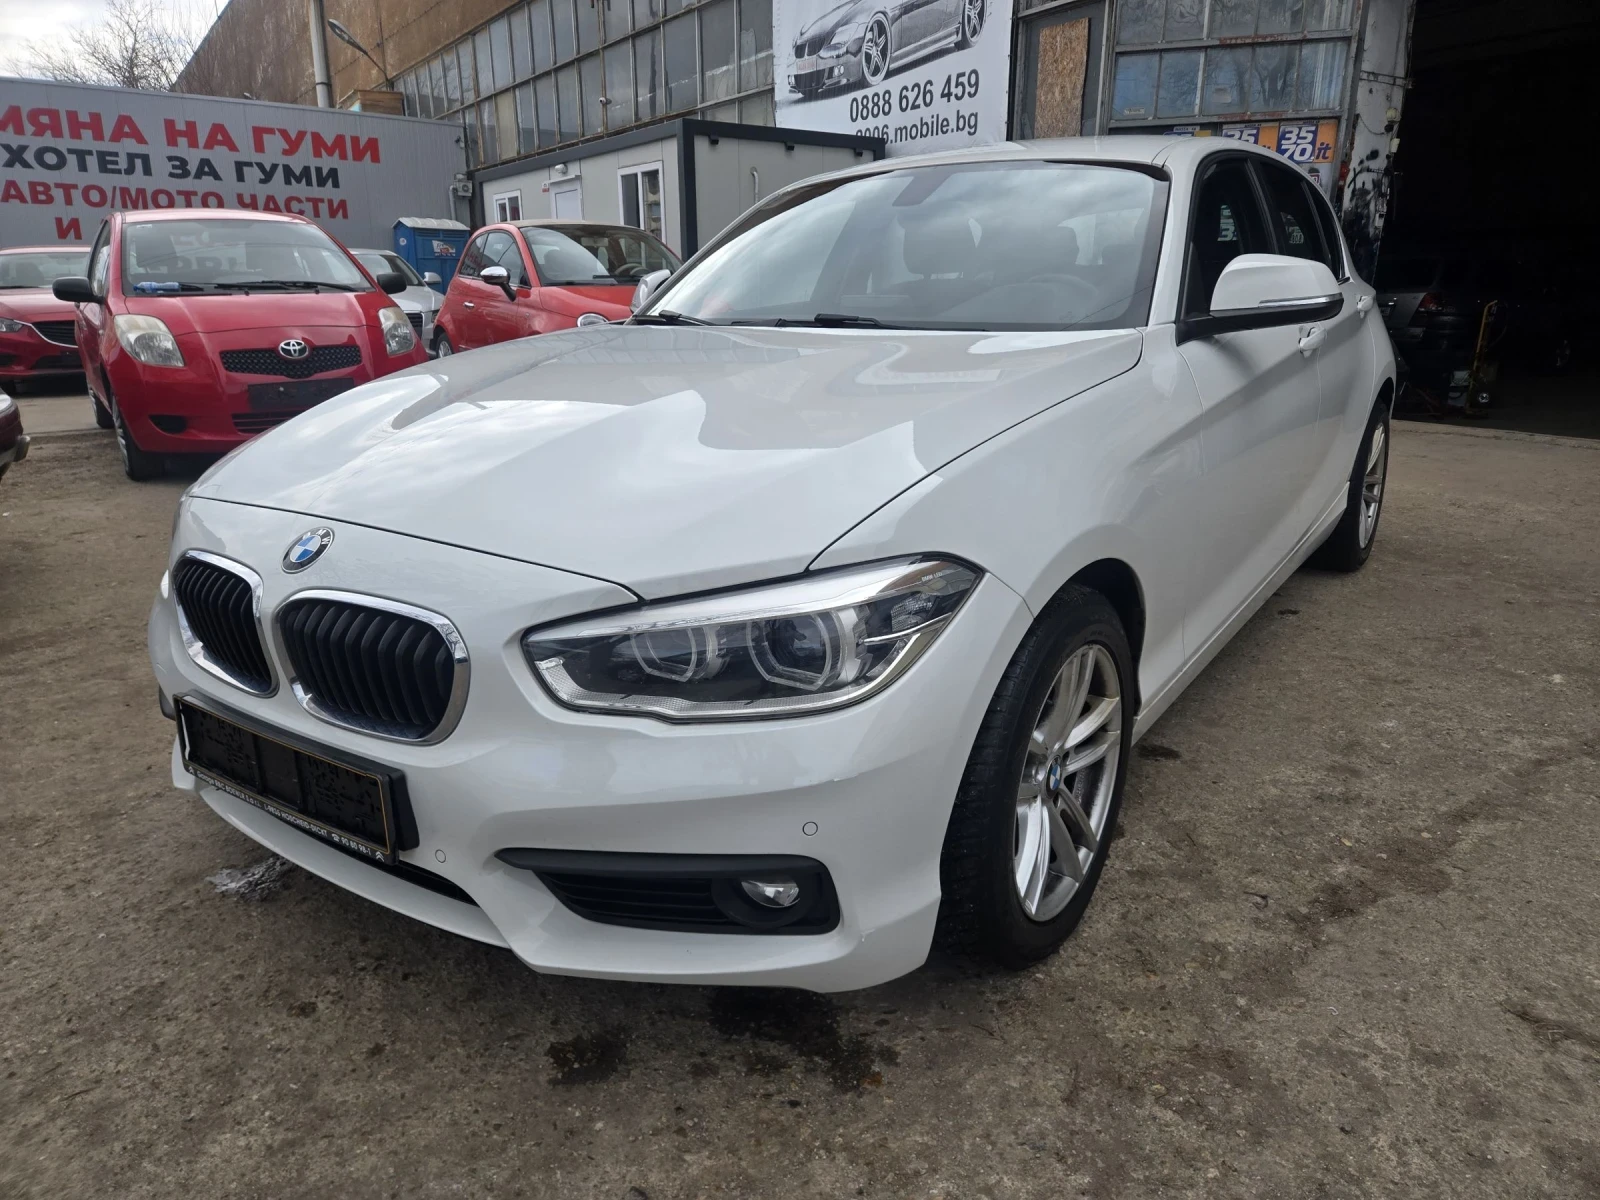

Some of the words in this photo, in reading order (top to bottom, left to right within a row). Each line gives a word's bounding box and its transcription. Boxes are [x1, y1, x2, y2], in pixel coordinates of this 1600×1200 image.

[849, 90, 892, 123] 0888
[898, 79, 934, 113] 626
[940, 68, 980, 103] 459
[163, 118, 240, 153] НА
[251, 125, 381, 164] ГУМИ
[1281, 126, 1316, 145] 35
[0, 143, 153, 177] ХОТЕЛ
[167, 155, 223, 182] ЗА
[234, 160, 341, 189] ГУМИ
[0, 179, 225, 210] АВТО/МОТО
[236, 192, 349, 220] ЧАСТИ
[54, 216, 82, 241] И
